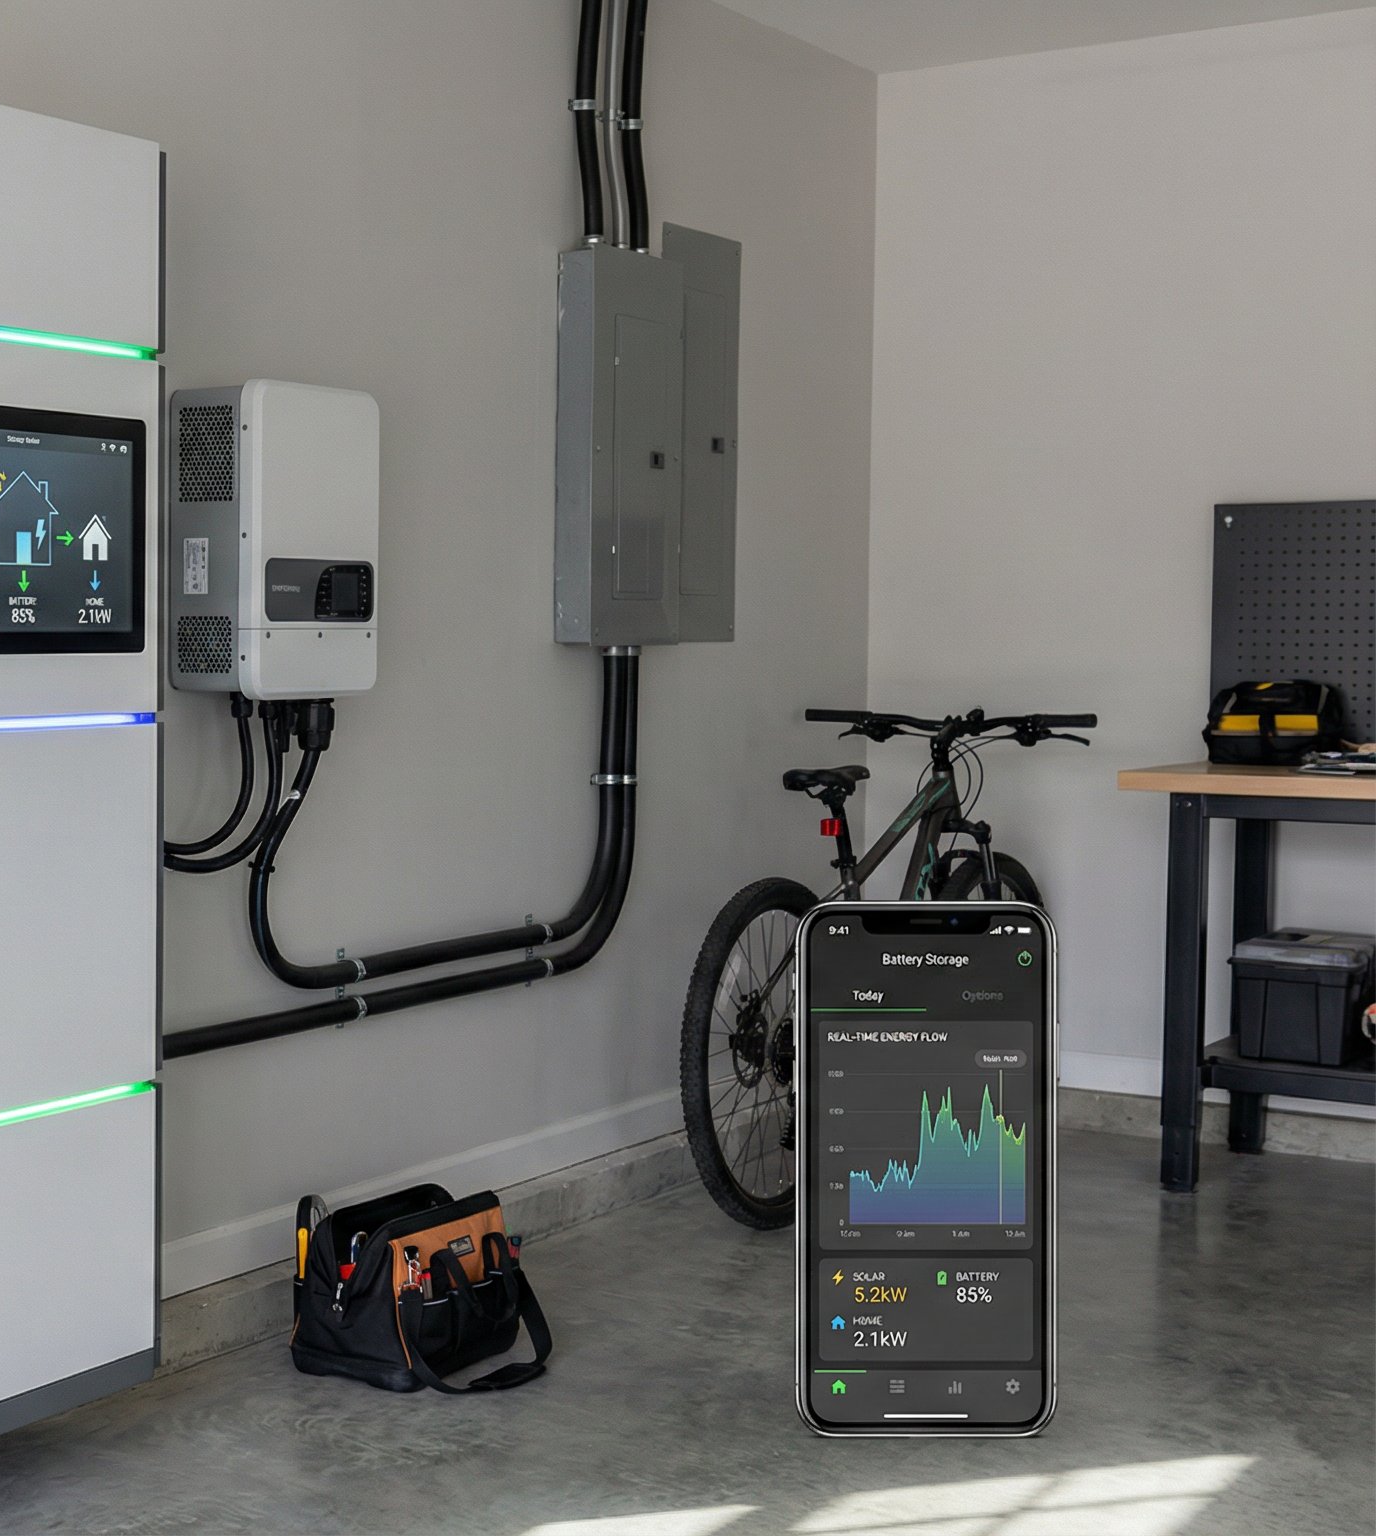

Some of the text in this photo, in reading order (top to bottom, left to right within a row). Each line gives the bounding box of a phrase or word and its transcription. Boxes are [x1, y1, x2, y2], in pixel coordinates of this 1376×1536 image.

[11, 608, 36, 624] 85%
[828, 925, 850, 935] 9:41
[882, 953, 969, 968] Battery Storage
[852, 990, 884, 1003] Today
[827, 1031, 949, 1043] REAL-TIME ENERGY FLOW
[853, 1271, 886, 1282] SOLAR
[956, 1271, 1000, 1282] BATTERY
[854, 1286, 908, 1303] 5.2kW
[956, 1286, 993, 1304] 85%
[853, 1331, 908, 1348] 2.1kW
